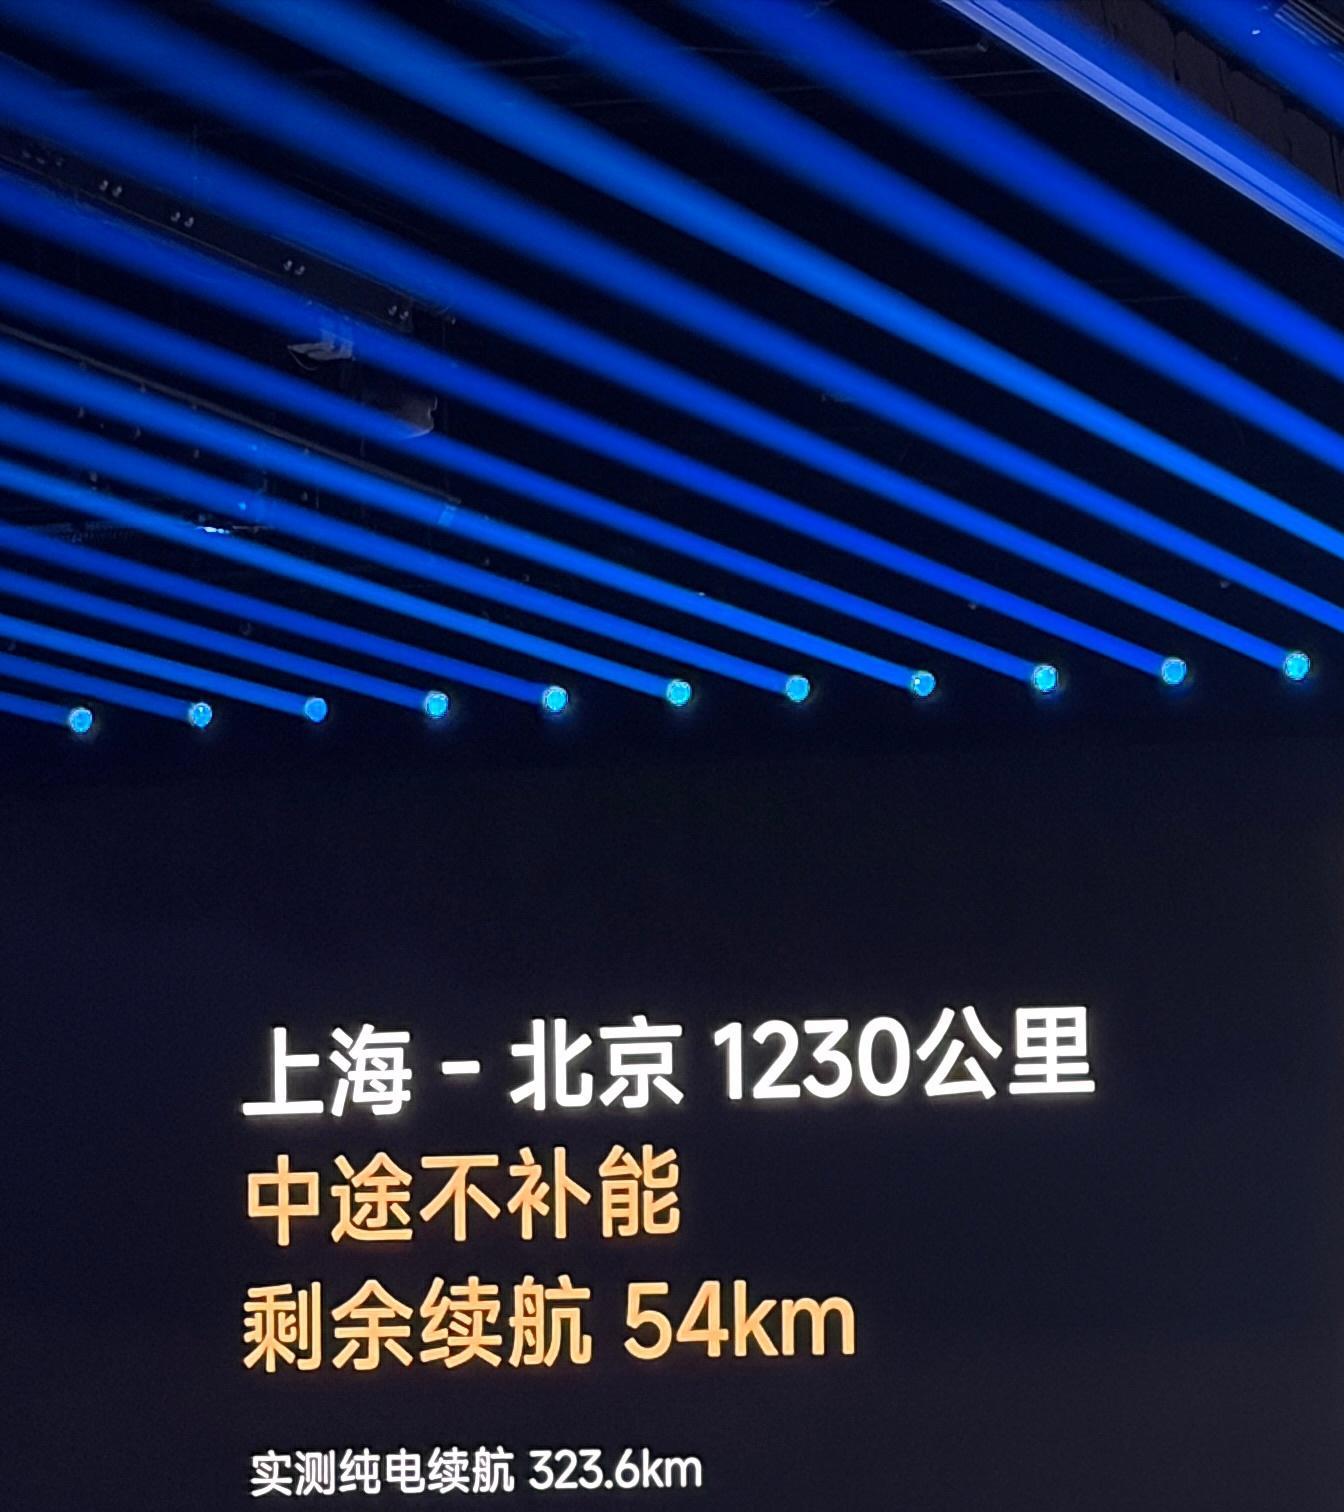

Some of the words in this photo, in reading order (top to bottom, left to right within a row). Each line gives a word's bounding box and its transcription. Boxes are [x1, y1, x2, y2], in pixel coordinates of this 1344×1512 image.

[241, 1023, 413, 1118] 上海
[509, 1014, 684, 1112] 北京
[713, 1005, 1096, 1100] 1230公里
[247, 1143, 681, 1247] 中途不补能
[243, 1274, 593, 1373] 剩余续航
[623, 1279, 856, 1360] 54km
[250, 1445, 515, 1497] 实测纯电续航
[528, 1447, 702, 1491] 323.6km
